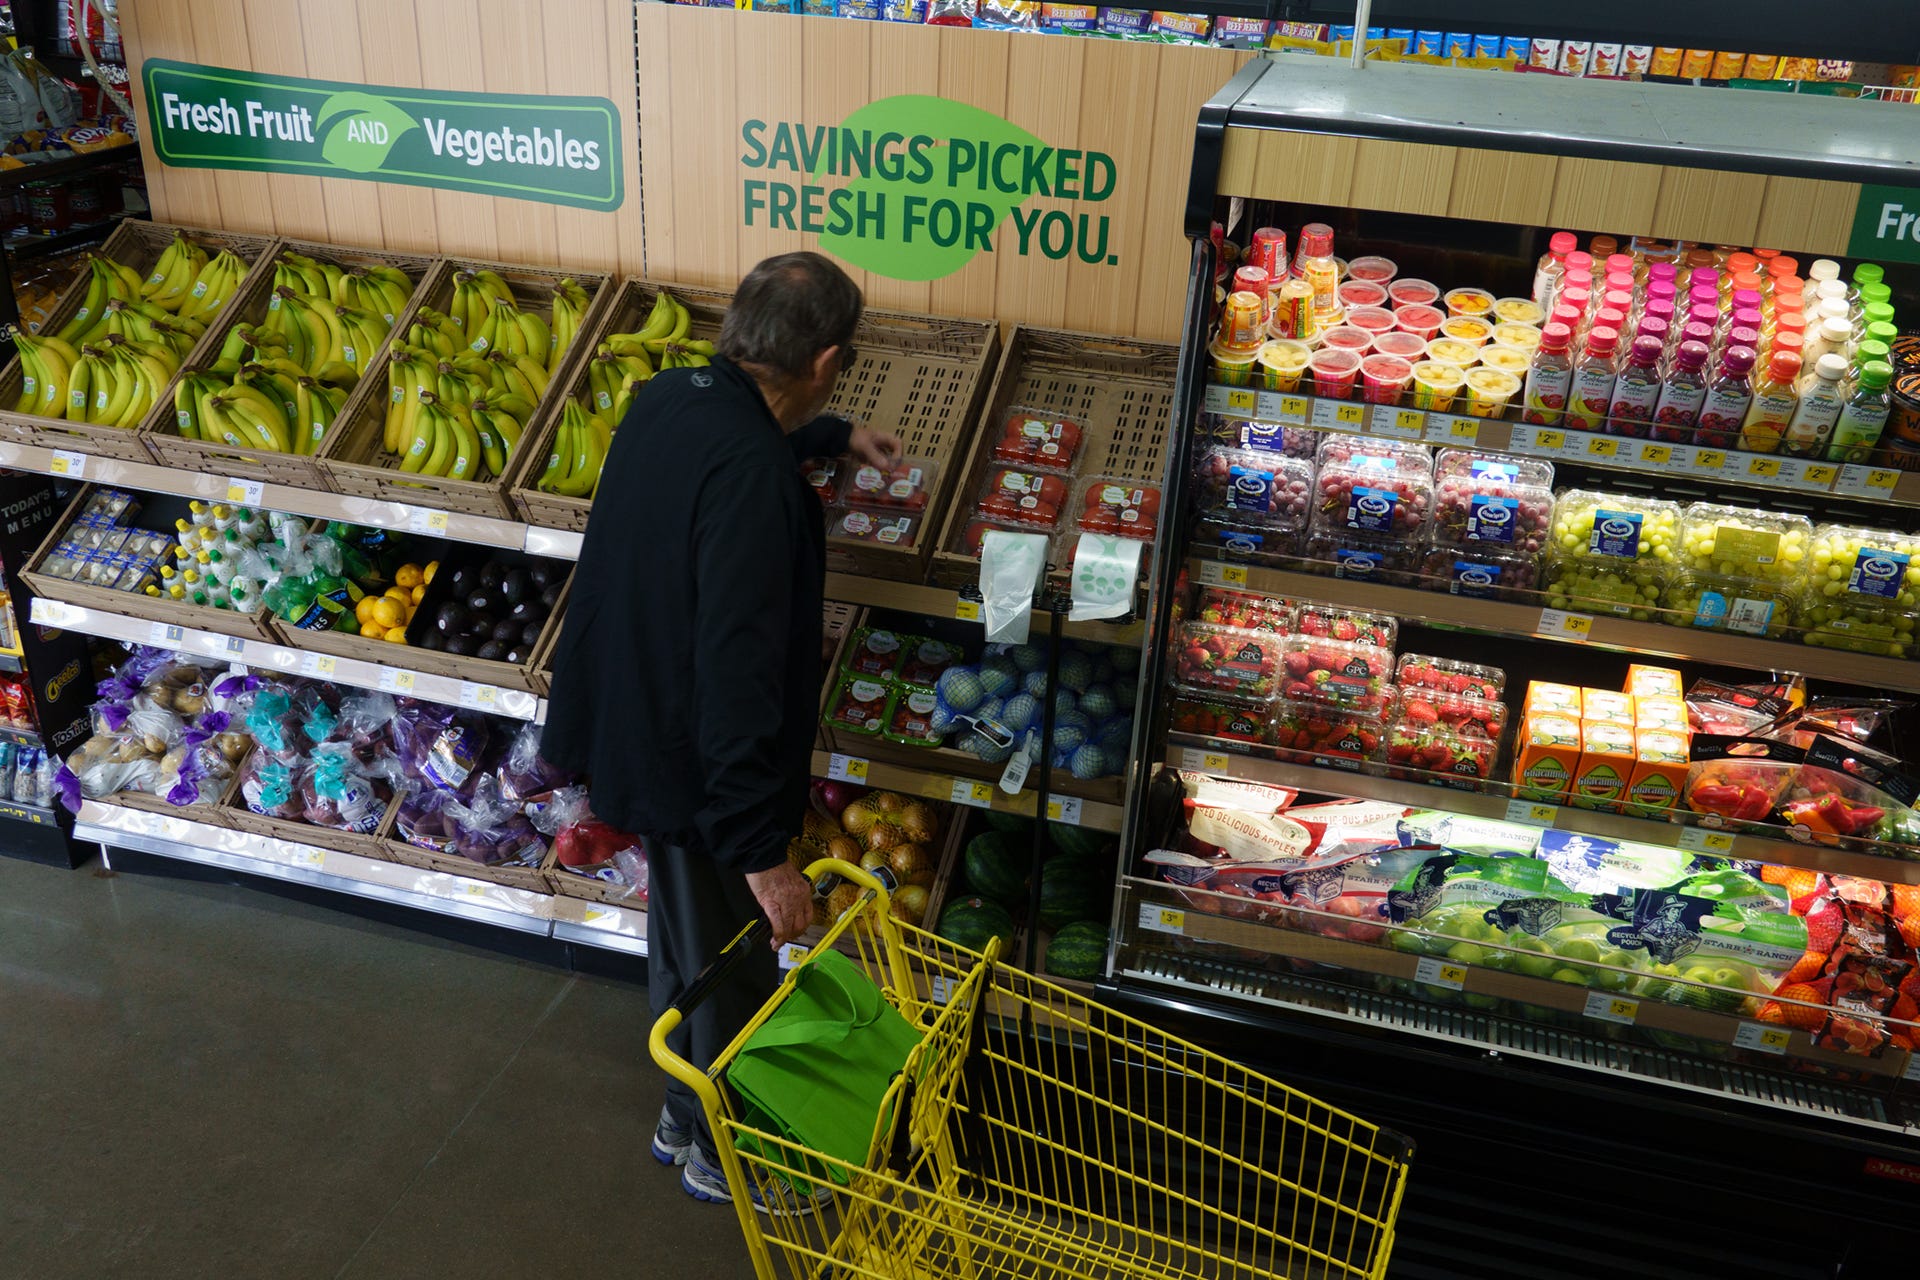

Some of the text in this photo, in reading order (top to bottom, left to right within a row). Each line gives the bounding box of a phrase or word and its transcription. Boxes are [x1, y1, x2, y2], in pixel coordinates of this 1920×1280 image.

[1226, 20, 1264, 32] BEEF JERKY
[162, 93, 241, 136] Fresh
[246, 101, 315, 143] Fruit
[347, 119, 389, 145] AND
[423, 117, 600, 171] Vegetables
[741, 119, 1117, 202] SAVINGS PICKED
[743, 179, 1118, 266] FRESH FOR YOU.
[1, 489, 50, 518] TODAY'S
[8, 506, 52, 534] MENU
[1239, 650, 1260, 660] GPC
[1346, 666, 1368, 674] GPC
[1231, 722, 1252, 734] GPC
[1340, 740, 1361, 750] GPC
[1455, 763, 1477, 774] GPC
[1524, 768, 1570, 780] Guacamole
[1578, 777, 1624, 788] Guacamole
[1244, 784, 1280, 801] APPLES
[1630, 786, 1678, 797] Guacamole
[1200, 806, 1296, 856] RED DELICIOUS APPLES
[1347, 874, 1380, 887] STARR
[1446, 883, 1524, 901] STARR RANC
[1703, 938, 1792, 962] STARR RANCH
